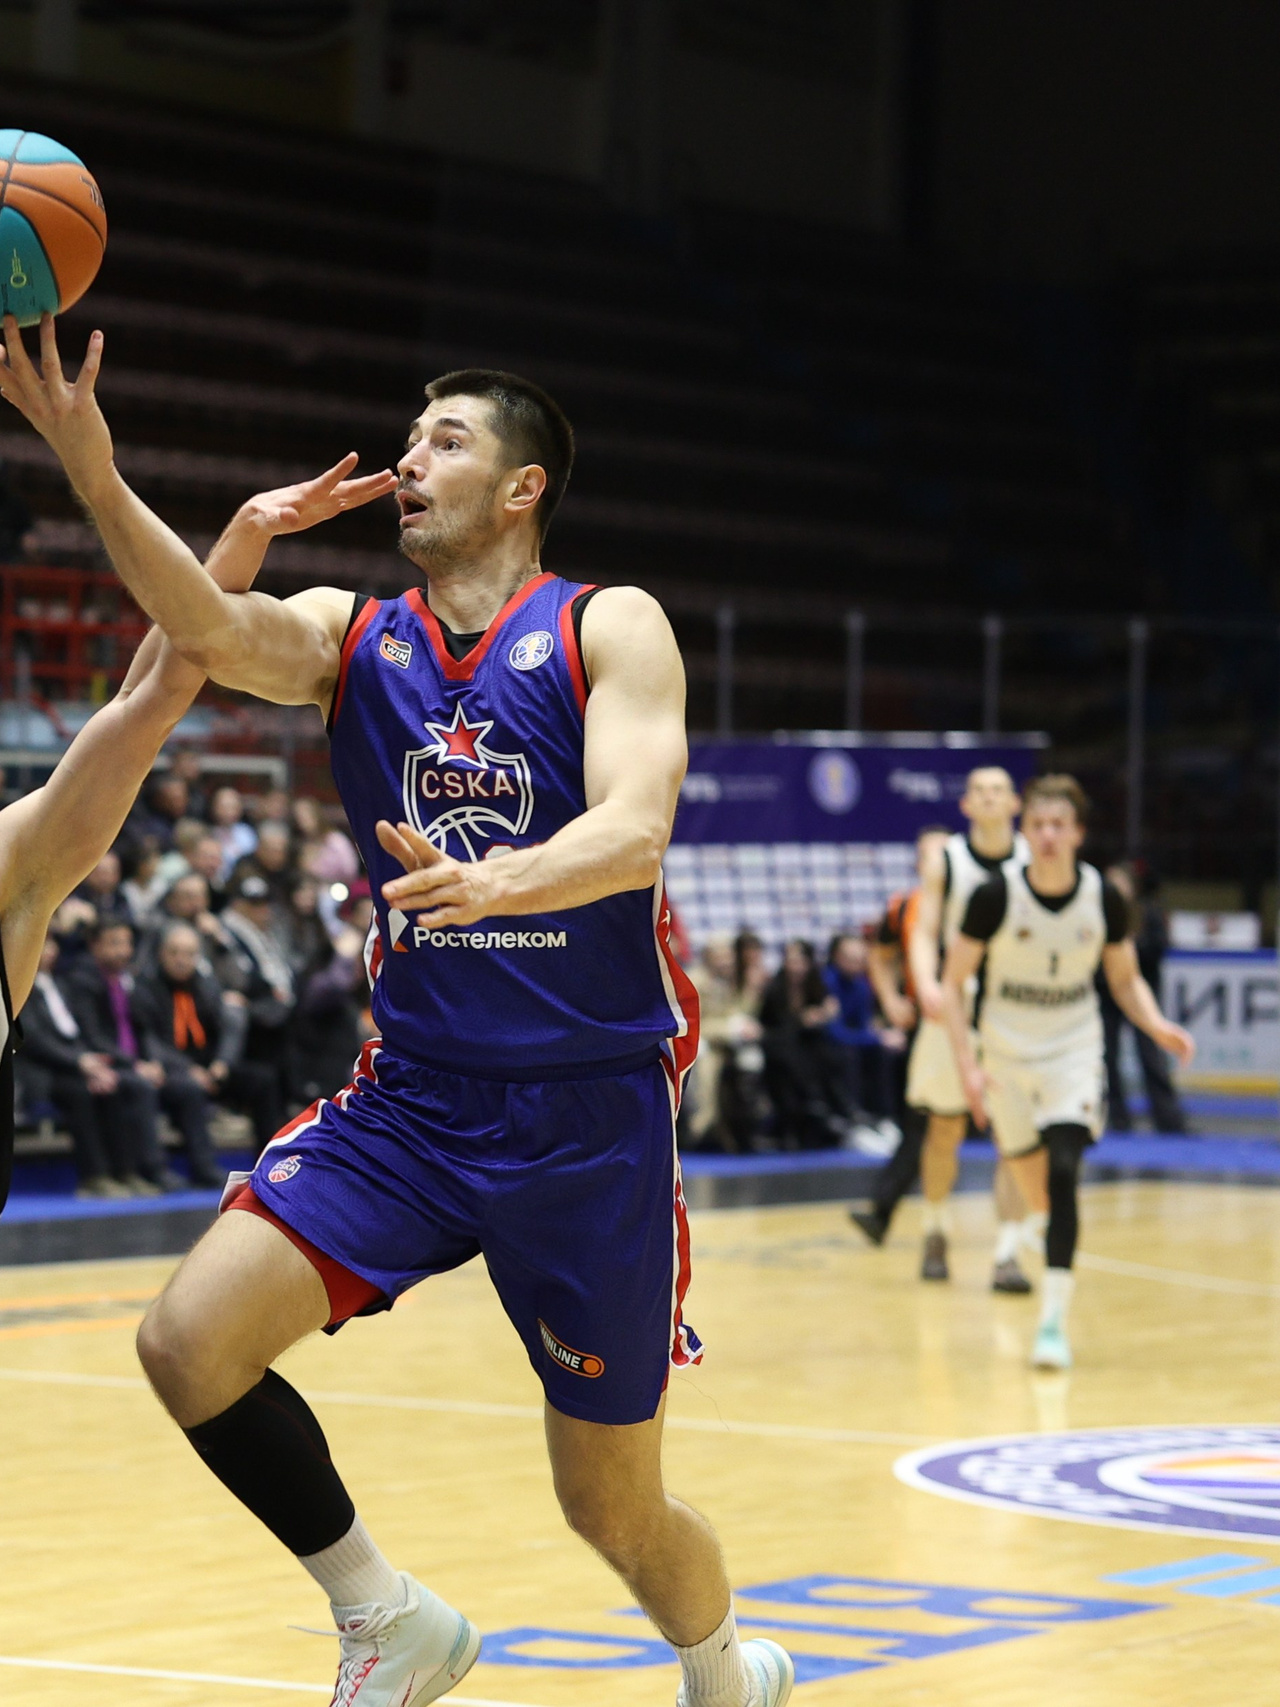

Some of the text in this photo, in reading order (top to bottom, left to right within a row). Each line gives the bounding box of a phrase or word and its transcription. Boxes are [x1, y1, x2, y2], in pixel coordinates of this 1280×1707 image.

[386, 644, 409, 662] WIN
[421, 769, 516, 799] CSKA
[413, 926, 568, 949] Ростелеком
[540, 1324, 581, 1369] WINLINE
